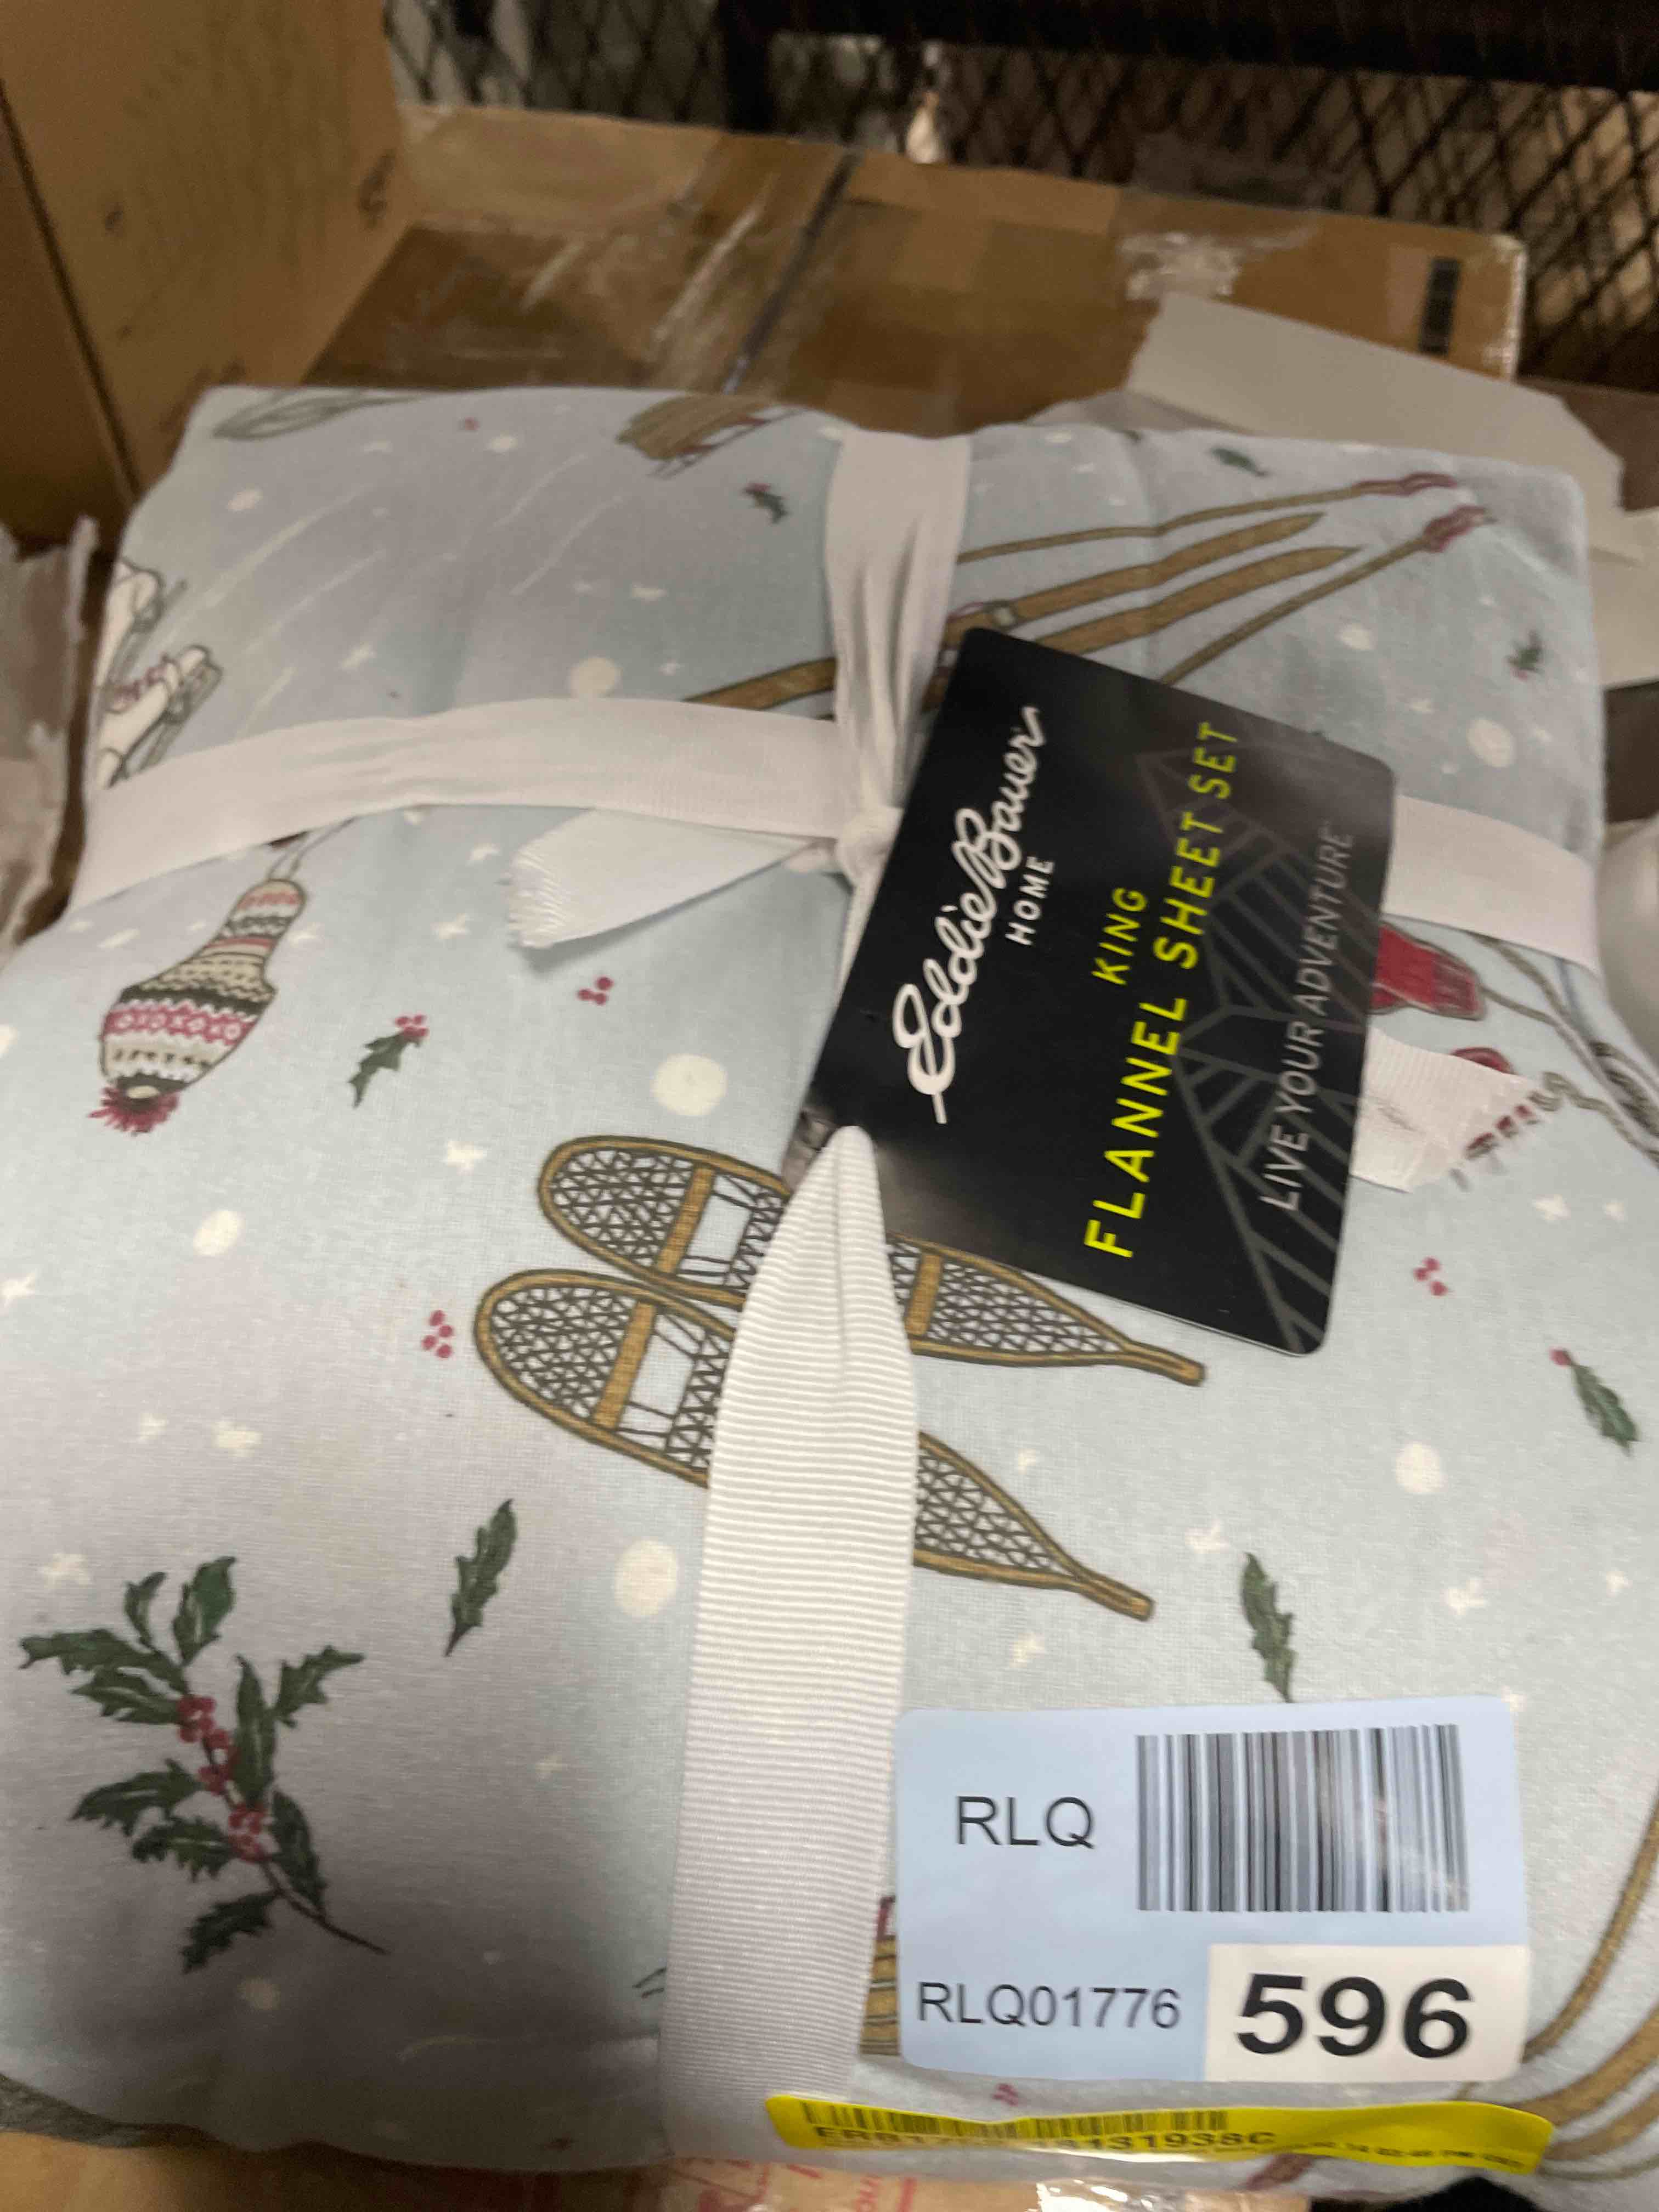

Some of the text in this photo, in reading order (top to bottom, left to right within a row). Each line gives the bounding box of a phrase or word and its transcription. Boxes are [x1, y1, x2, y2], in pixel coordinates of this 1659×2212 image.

[893, 706, 1046, 1125] Eddie Bauer
[1005, 855, 1055, 946] HOME
[1091, 887, 1148, 986] KING
[1084, 721, 1238, 1257] FLANNEL SHEET SET
[1259, 825, 1355, 1211] LIVE YOUR ADVENTURE
[956, 1796, 1095, 1849] RLQ
[916, 1981, 1181, 2029] RLQ01776
[1234, 1973, 1473, 2059] 596
